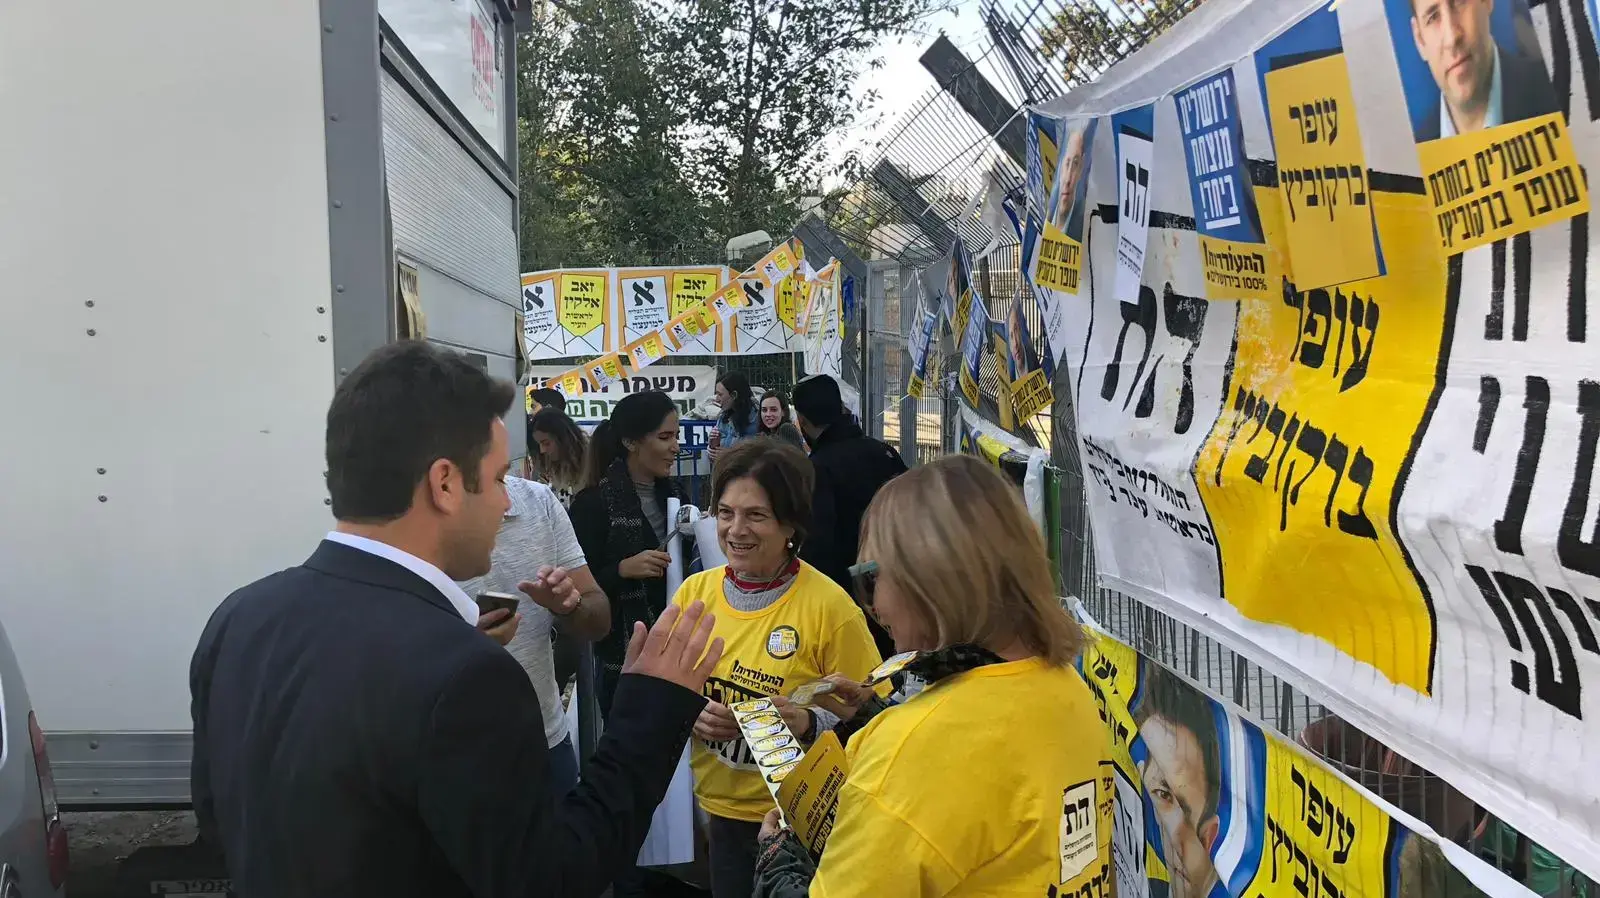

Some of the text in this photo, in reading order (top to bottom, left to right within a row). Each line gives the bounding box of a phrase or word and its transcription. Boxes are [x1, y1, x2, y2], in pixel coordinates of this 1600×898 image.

[1179, 76, 1230, 135] ירושלים
[1289, 97, 1338, 146] עופר
[1191, 127, 1234, 177] מנצחת
[1474, 122, 1561, 188] ירושלים
[1124, 158, 1149, 228] הת
[1280, 162, 1366, 223] ברקוביץ
[1513, 165, 1581, 218] עופר
[524, 285, 544, 312] א
[564, 293, 600, 310] אלקין
[571, 281, 595, 293] זאב
[632, 280, 656, 306] א
[683, 278, 707, 290] זאב
[1242, 276, 1268, 291] 100%
[1282, 275, 1380, 394] עופר
[1214, 384, 1379, 541] ברקוביץ
[762, 685, 780, 695] 100%
[1064, 797, 1089, 836] הת
[1291, 763, 1355, 864] עופר
